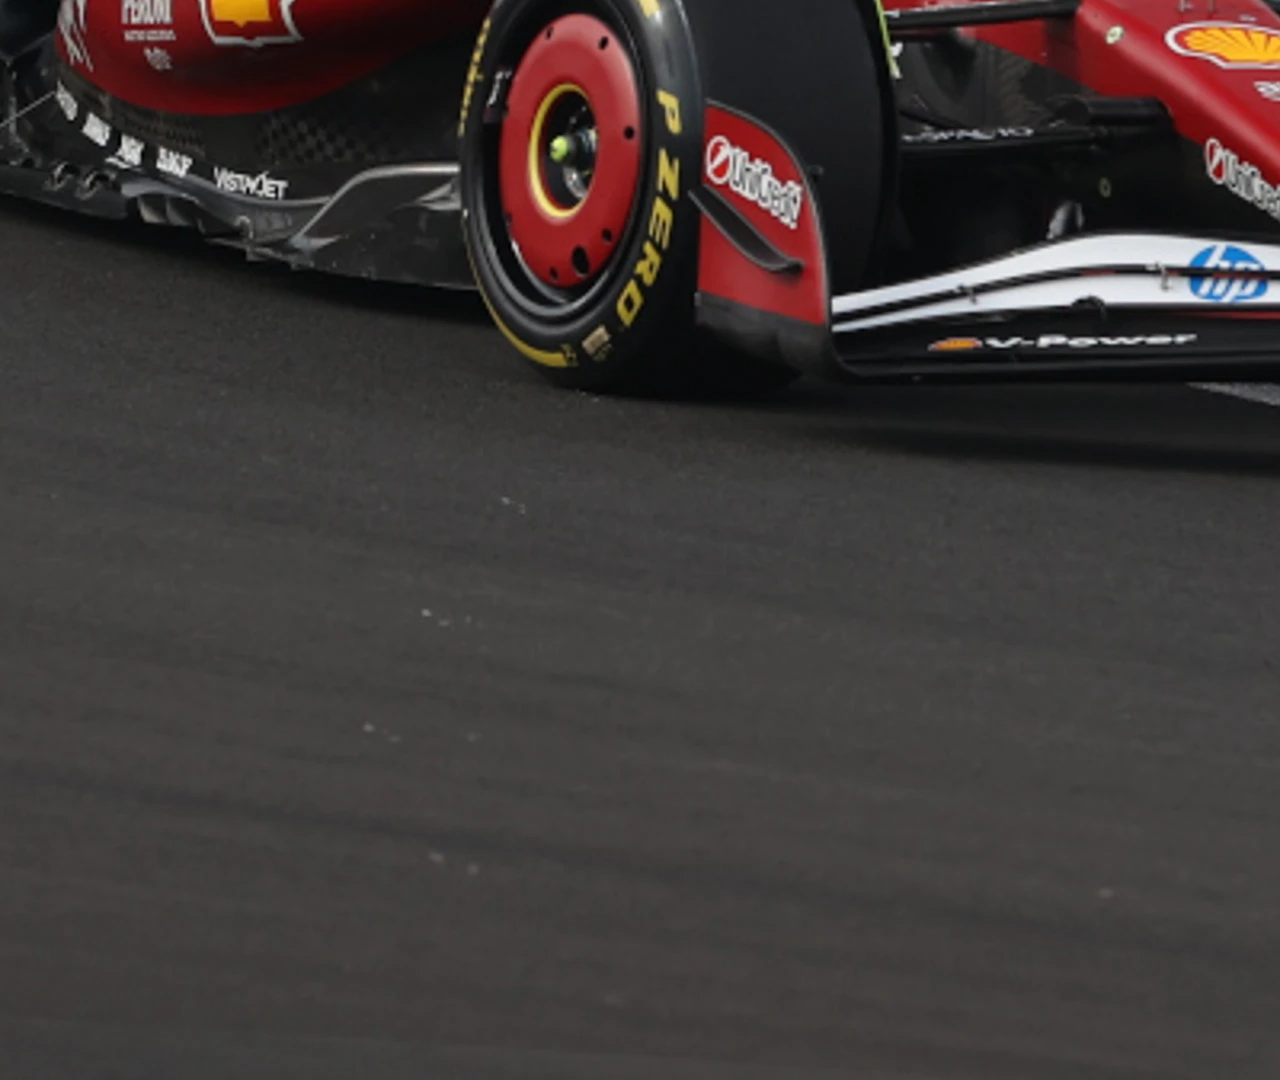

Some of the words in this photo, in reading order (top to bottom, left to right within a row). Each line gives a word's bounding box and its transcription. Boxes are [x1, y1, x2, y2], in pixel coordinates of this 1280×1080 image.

[656, 88, 683, 135] P
[616, 147, 680, 328] ZERO
[1196, 245, 1261, 301] hp
[985, 334, 1197, 348] V-Power
